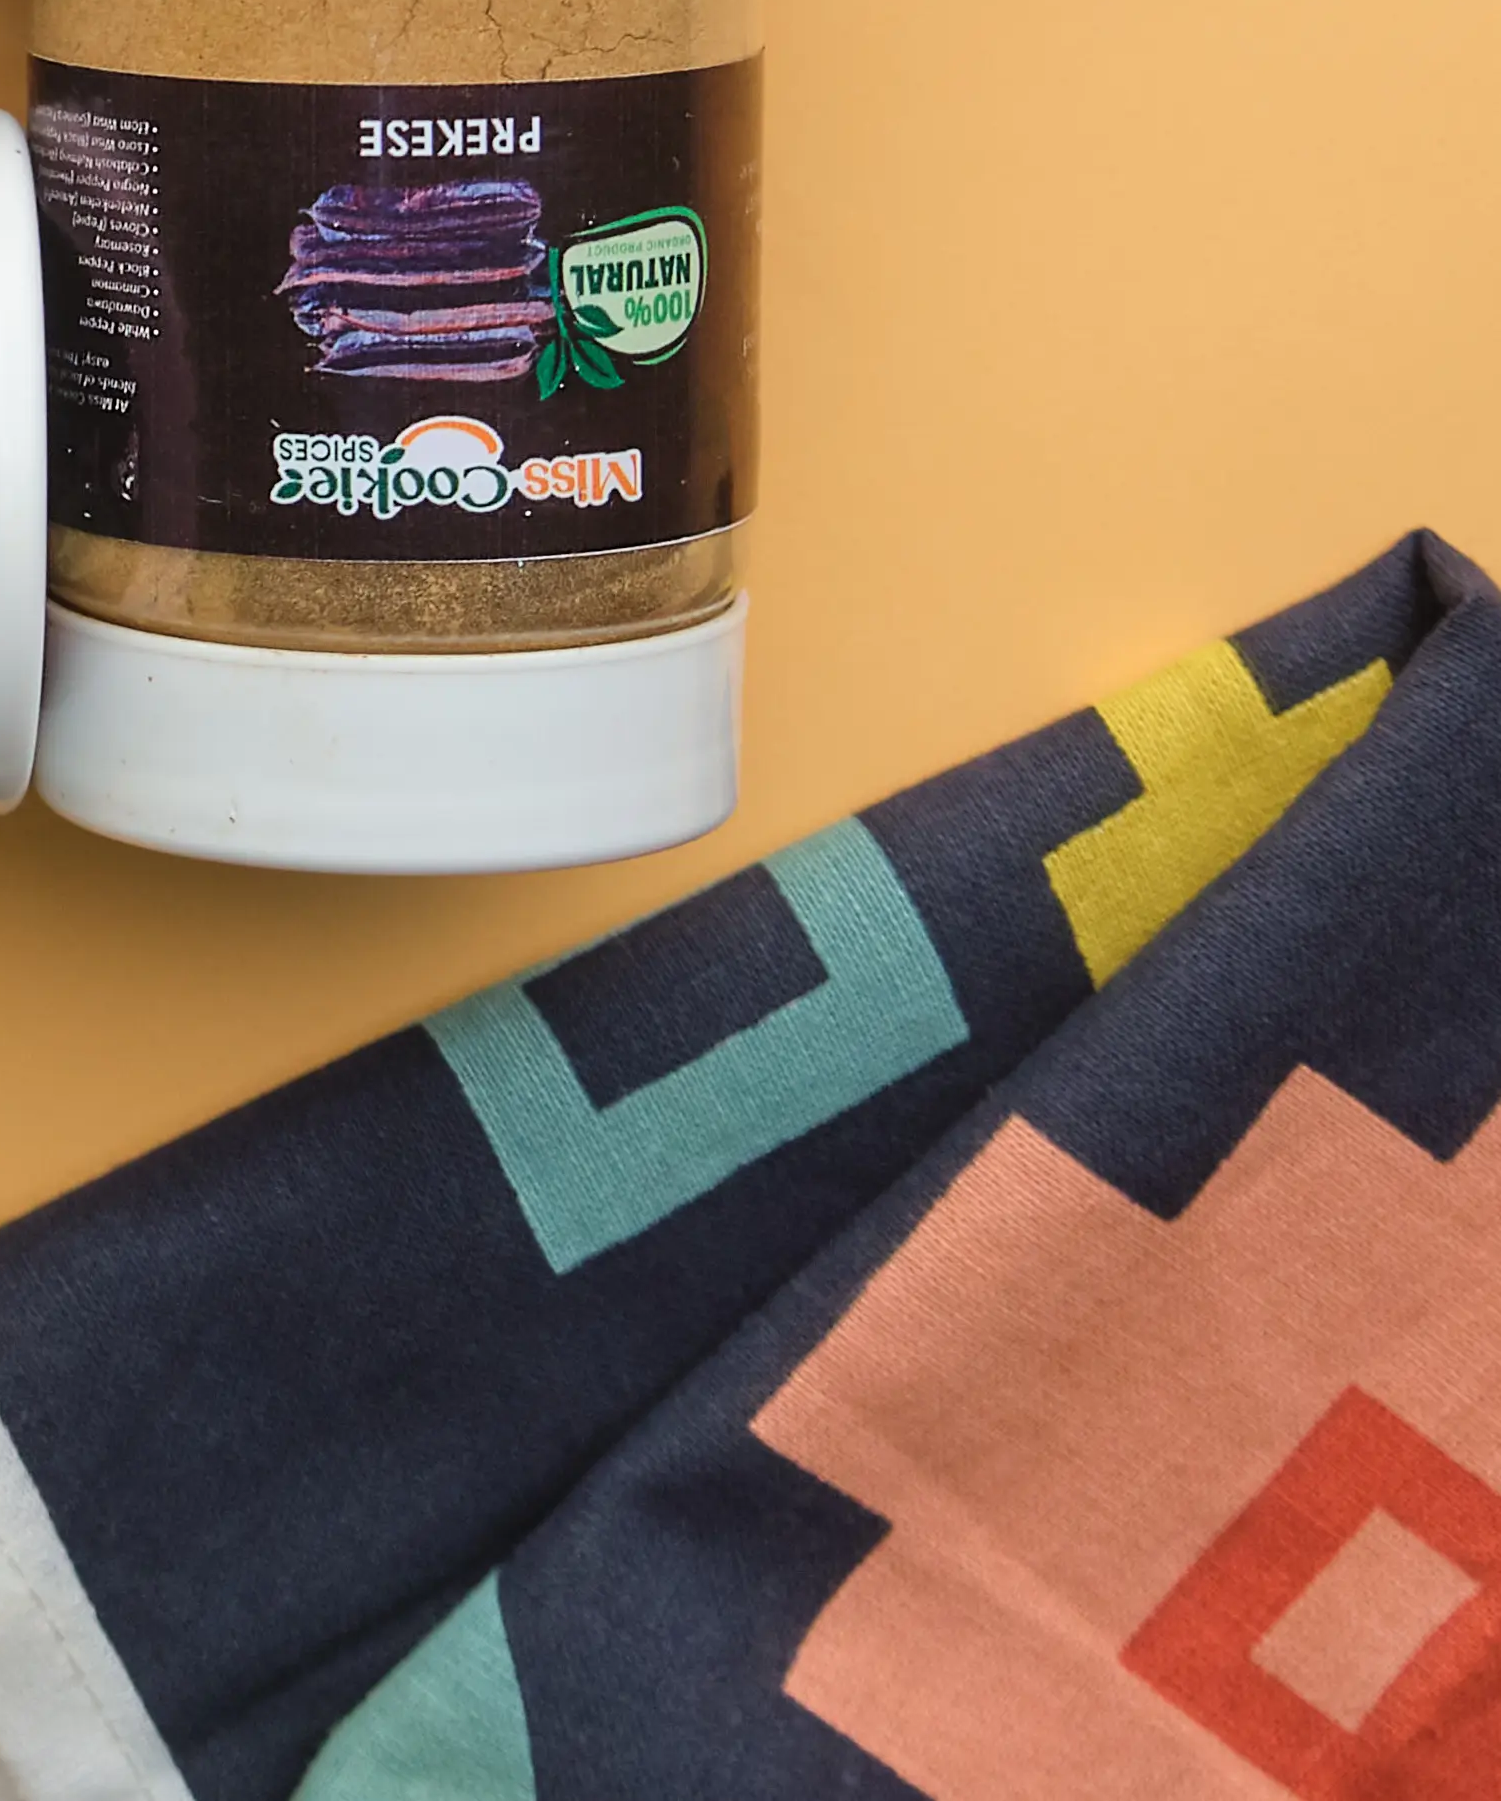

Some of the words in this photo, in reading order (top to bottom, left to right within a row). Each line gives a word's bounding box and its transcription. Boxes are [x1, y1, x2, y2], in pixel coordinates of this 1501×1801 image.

[360, 116, 541, 157] PREKESE
[586, 240, 643, 258] PRODUCT
[646, 234, 691, 254] ORGANIC
[569, 253, 691, 298] NATURAL
[624, 290, 693, 328] 100%
[278, 438, 374, 462] SPICES
[309, 465, 508, 514] Cookie
[523, 454, 637, 502] Miss
